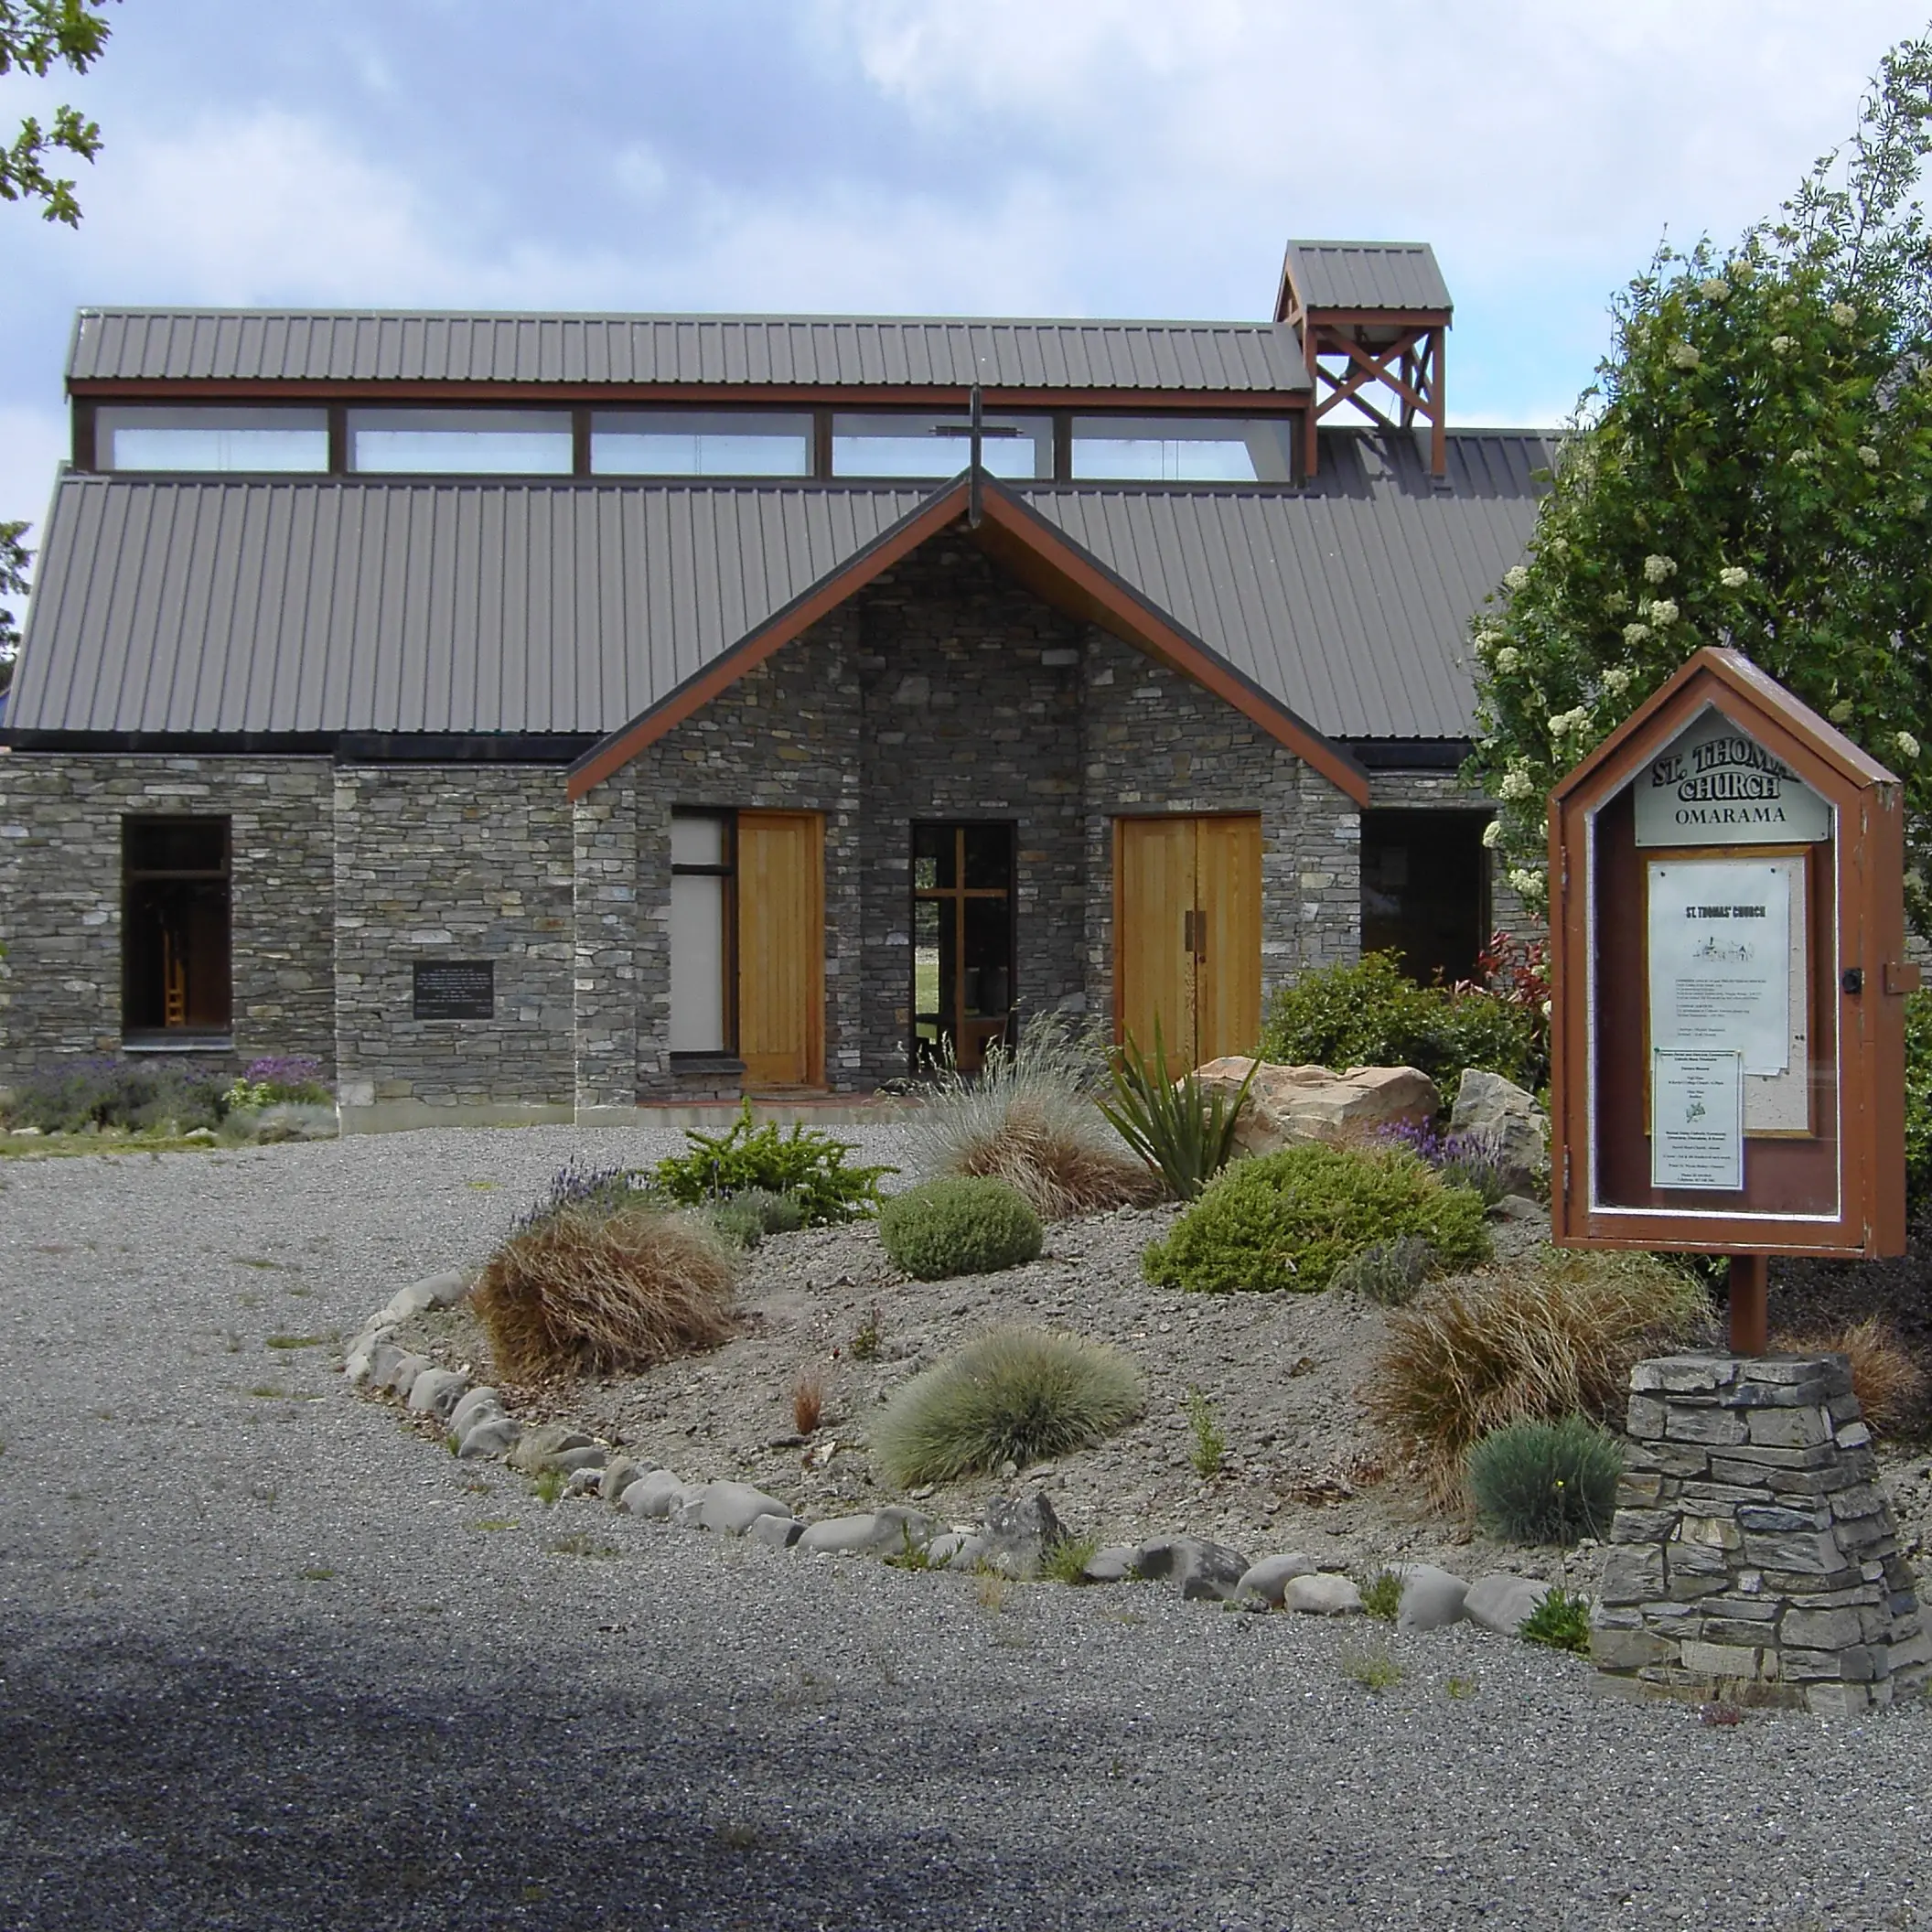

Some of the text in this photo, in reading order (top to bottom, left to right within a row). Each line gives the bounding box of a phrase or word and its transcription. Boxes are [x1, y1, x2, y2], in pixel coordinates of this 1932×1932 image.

[1693, 738, 1801, 783] THOM
[1678, 772, 1781, 802] CHURCH
[1676, 806, 1786, 824] OMARAMA
